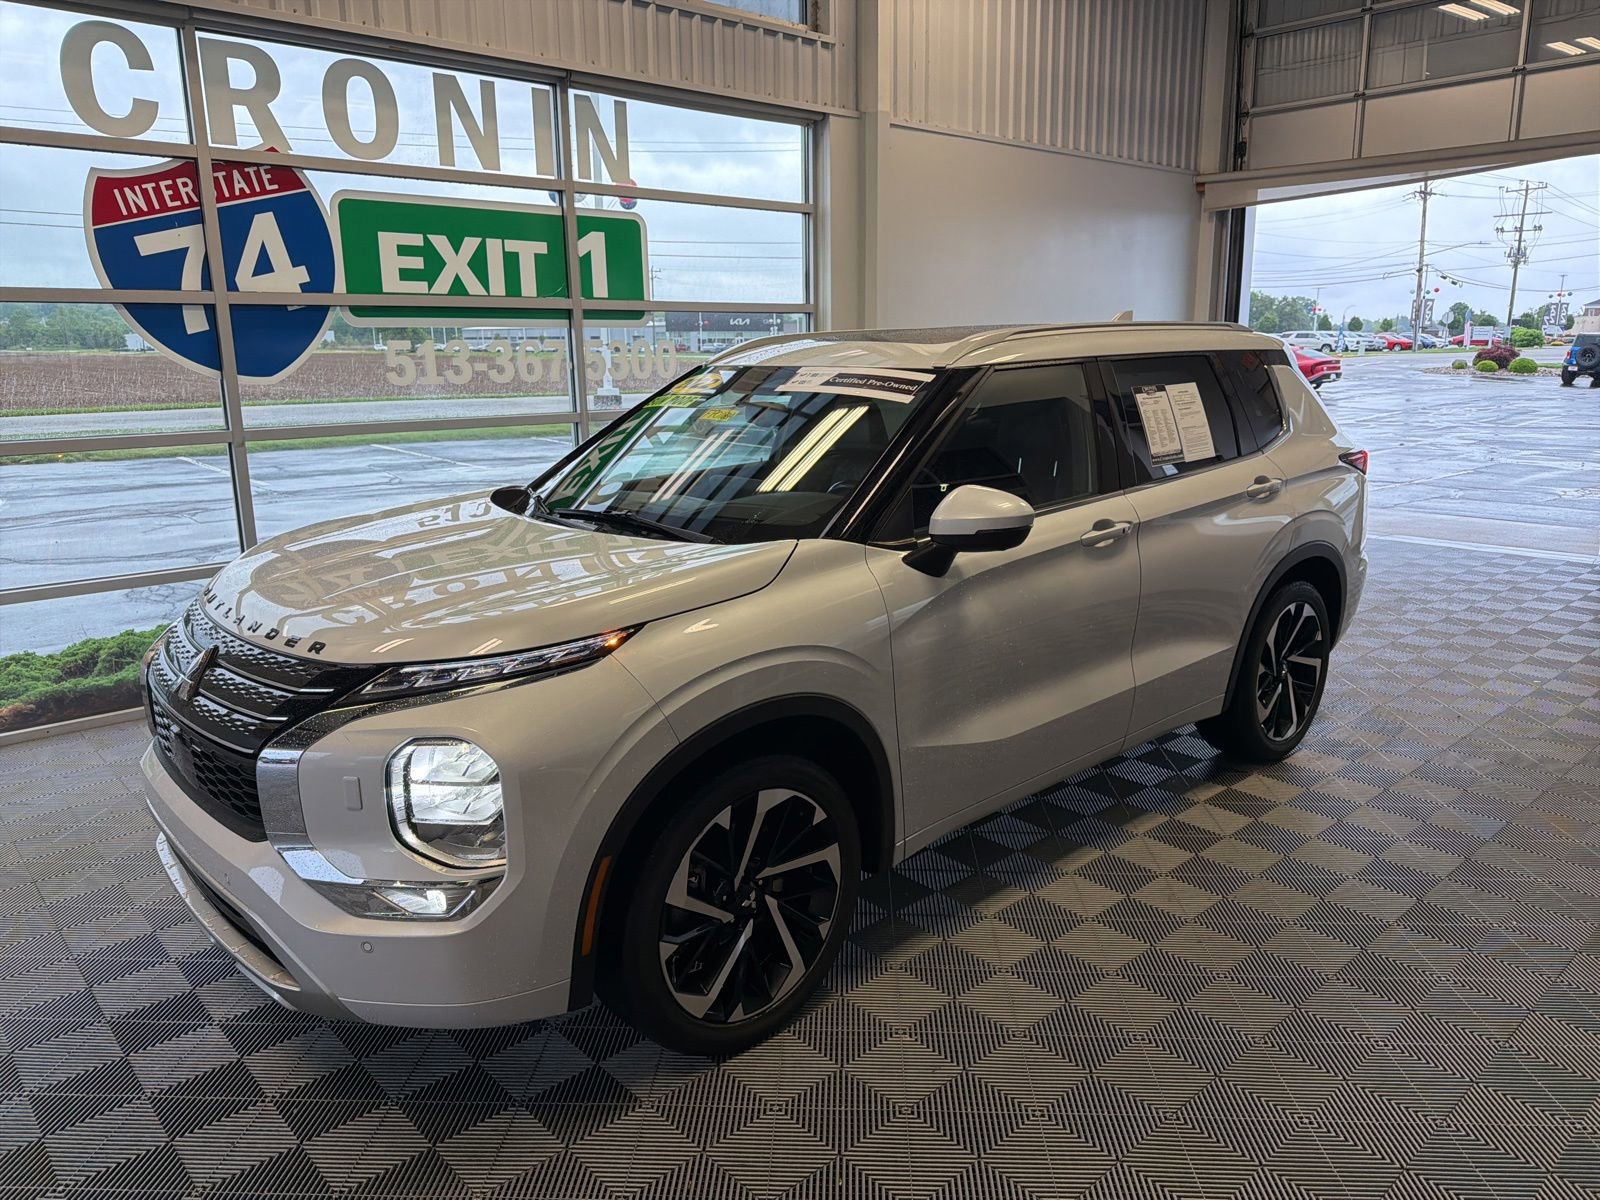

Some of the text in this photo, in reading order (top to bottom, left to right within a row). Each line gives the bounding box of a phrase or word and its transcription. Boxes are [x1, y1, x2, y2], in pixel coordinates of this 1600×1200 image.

[59, 19, 631, 184] CRONIN
[113, 165, 279, 216] INTERTATE
[133, 211, 311, 335] 74
[377, 231, 609, 299] EXIT 1
[829, 376, 918, 391] Certified Pre-Owned
[203, 587, 327, 655] OUTLANDER
